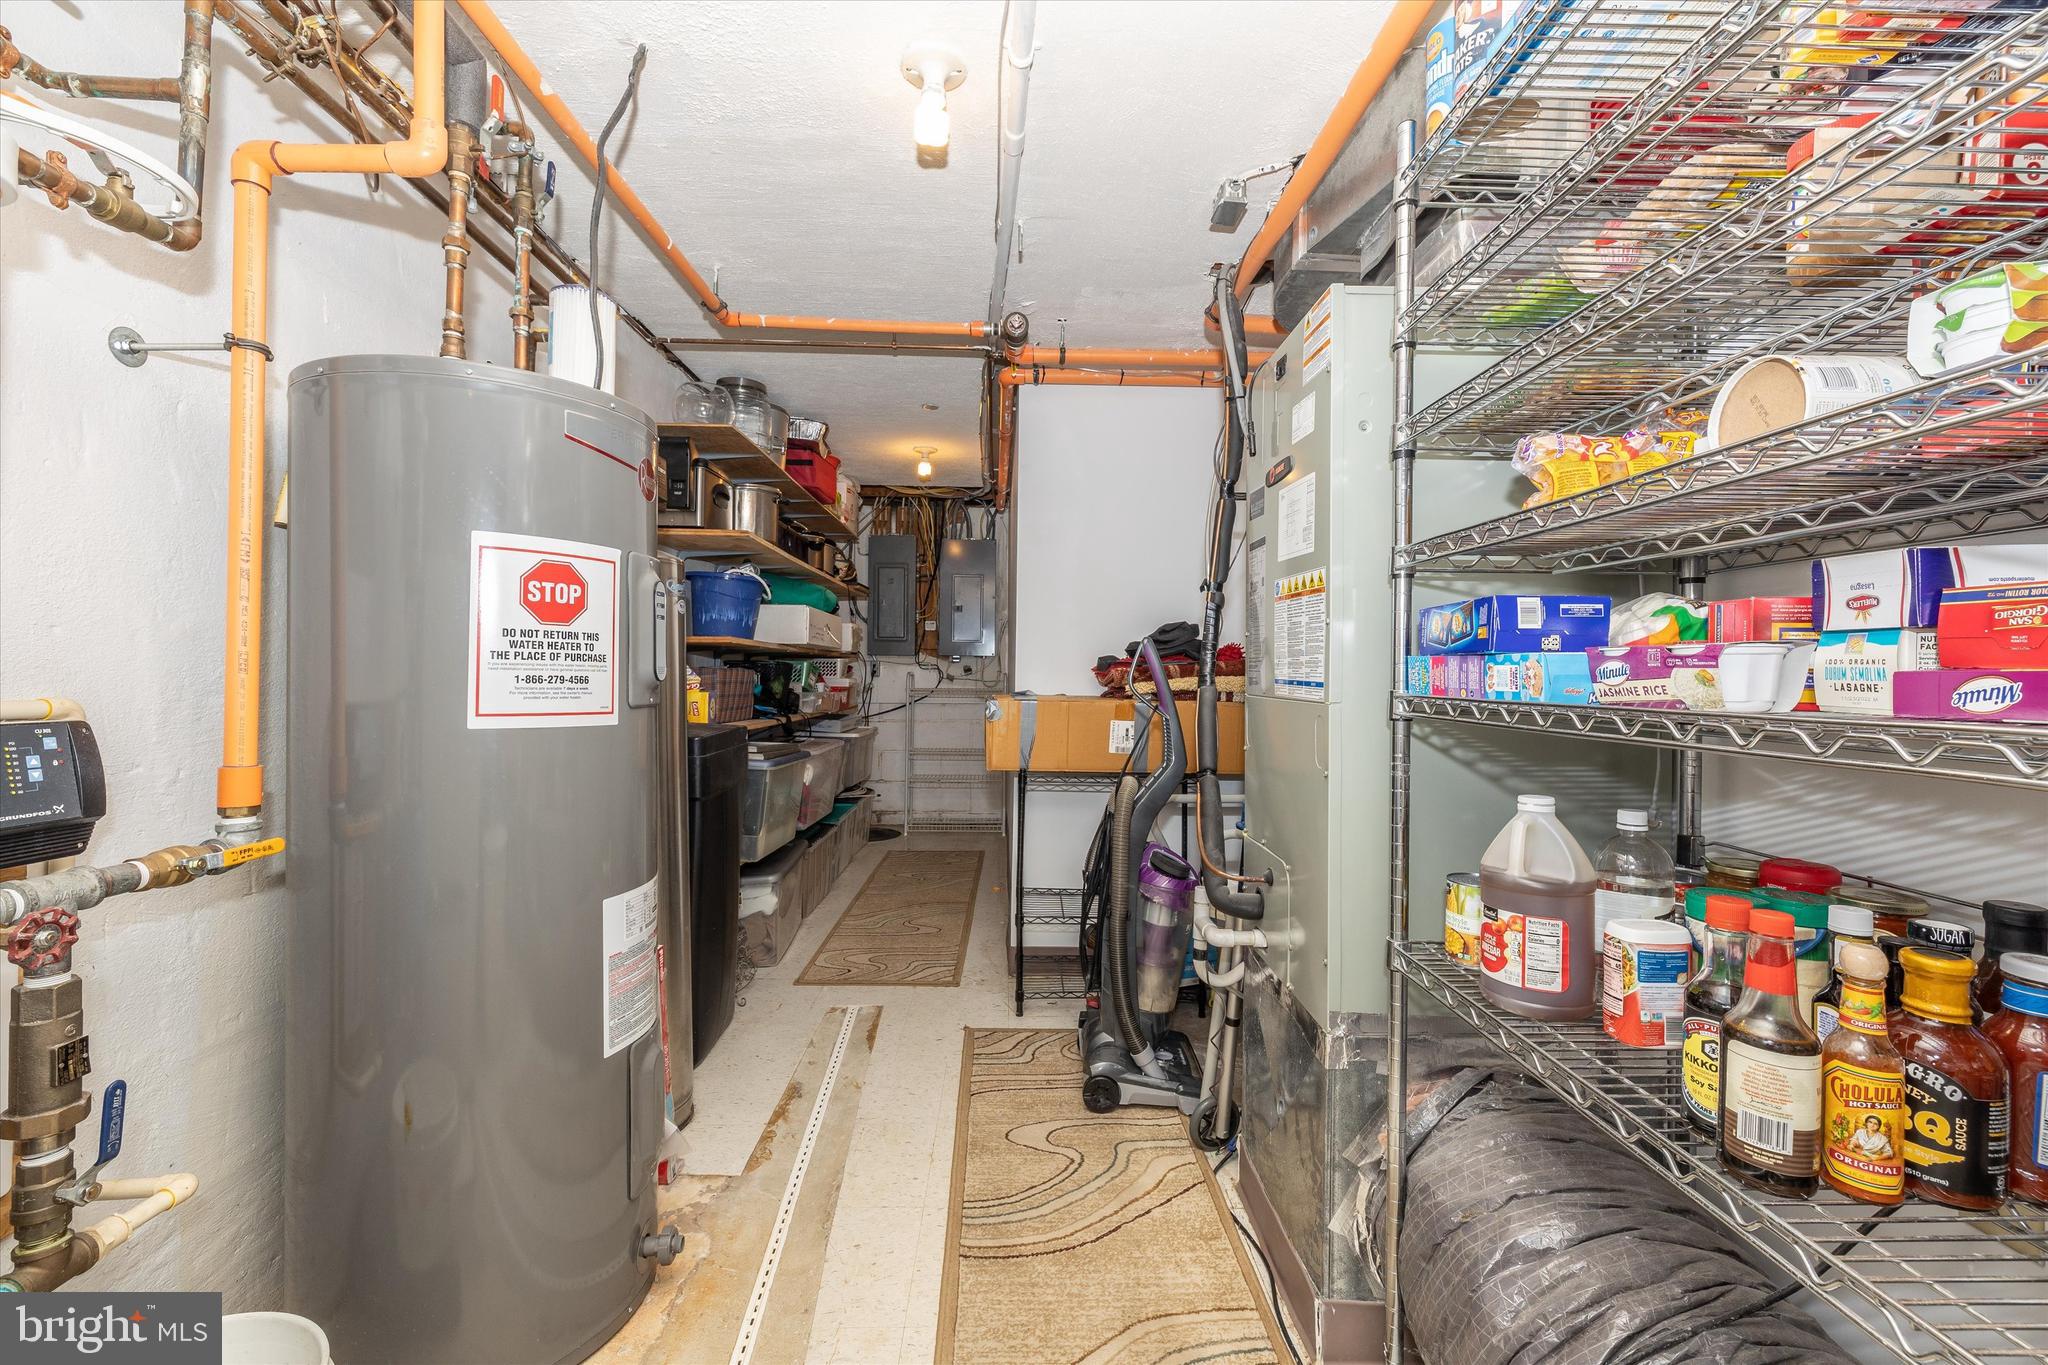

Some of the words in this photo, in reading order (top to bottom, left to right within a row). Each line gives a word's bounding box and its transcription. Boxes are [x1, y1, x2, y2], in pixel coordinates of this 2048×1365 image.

[528, 581, 581, 604] STOP
[1850, 582, 1875, 591] Lasagna
[2031, 587, 2048, 595] OLOR
[1995, 605, 2047, 619] GIORGIO
[2009, 616, 2032, 625] SAN
[502, 628, 516, 637] DO
[520, 629, 540, 638] NOT
[543, 630, 579, 640] RETURN
[582, 632, 600, 641] THIS
[509, 640, 544, 649] WATER
[547, 642, 581, 651] HEATER
[585, 643, 594, 652] TO
[490, 651, 510, 660] THE
[514, 652, 546, 661] PLACE
[550, 652, 561, 661] OF
[565, 653, 607, 662] PURCHASE
[515, 675, 589, 684] 1-866-279-4566
[1597, 665, 1629, 681] Minute
[1824, 667, 1847, 681] DURUM
[1850, 667, 1887, 681] SEMOLINA
[1599, 687, 1640, 697] JASMINE
[1644, 685, 1668, 695] RICE
[1834, 683, 1879, 693] LASAGNE
[1953, 684, 2020, 707] Minute
[0, 810, 52, 822] GRUNDFOS
[1930, 928, 1965, 944] SUGAR
[1685, 1051, 1718, 1073] KIKKO
[1690, 1076, 1705, 1088] Soy
[1831, 1076, 1902, 1106] CHOLULA
[1905, 1084, 1937, 1105] NEY
[1955, 1118, 1967, 1151] SAUCE
[1834, 1152, 1898, 1175] ORIGINAL
[1905, 1167, 1921, 1177] (510
[1922, 1174, 1949, 1186] grams)
